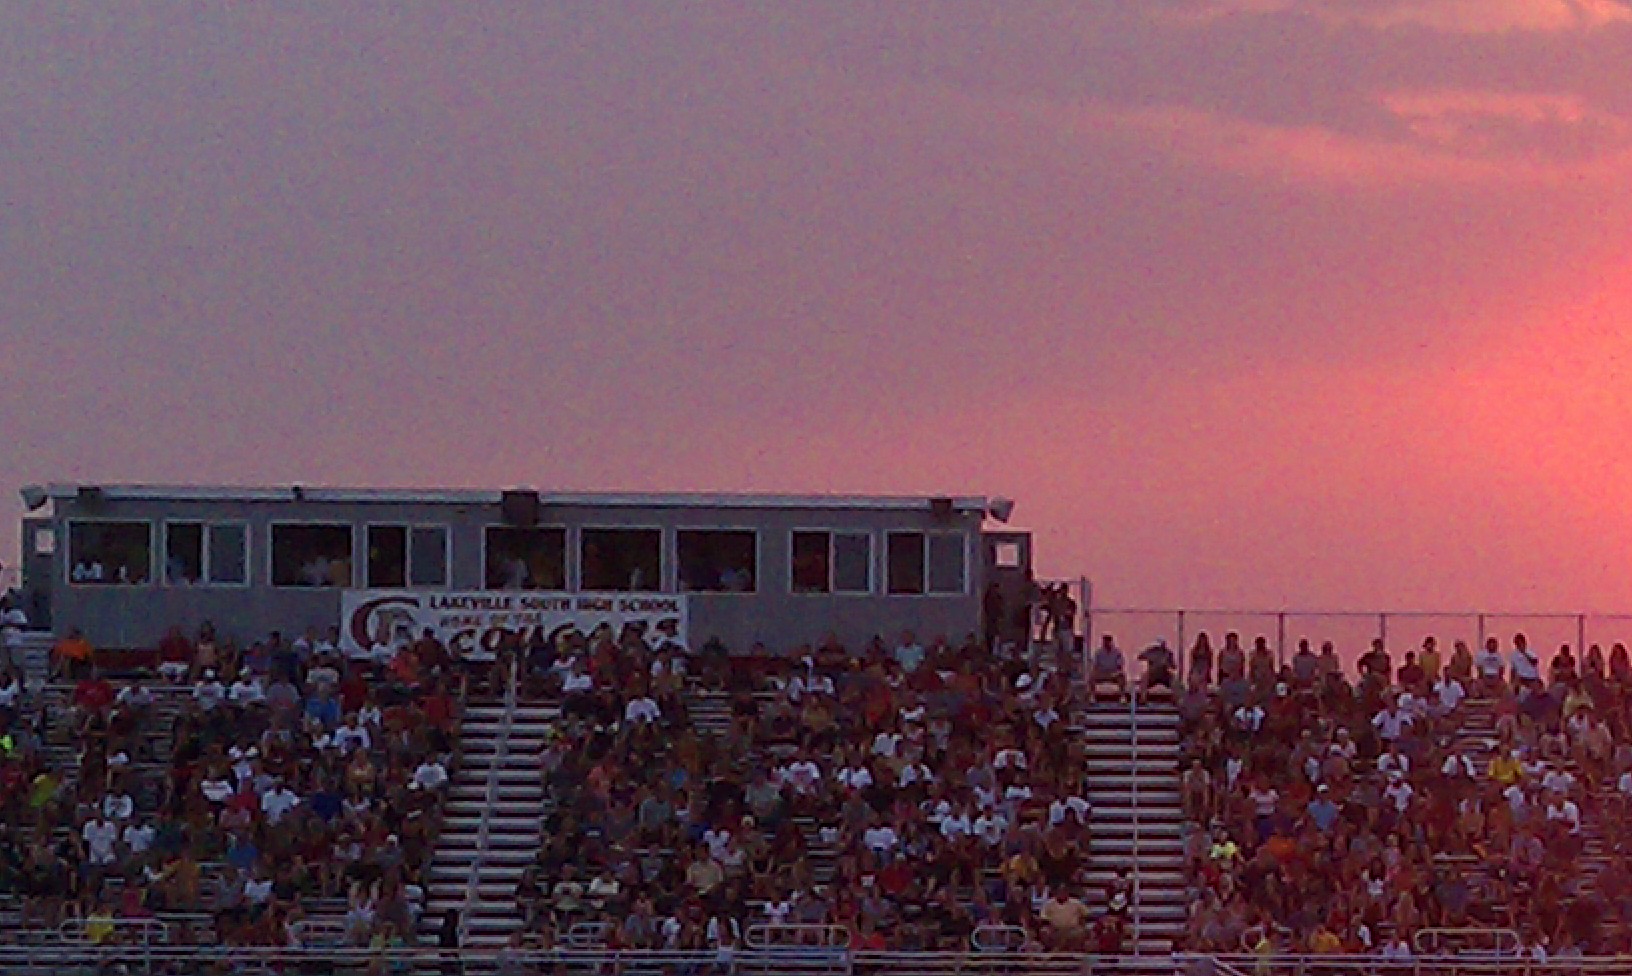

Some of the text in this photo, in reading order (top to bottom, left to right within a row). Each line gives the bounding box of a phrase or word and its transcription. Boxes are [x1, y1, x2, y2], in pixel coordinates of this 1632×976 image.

[429, 596, 679, 613] LAKEVILLE SOUTH HIGH SCHOOL
